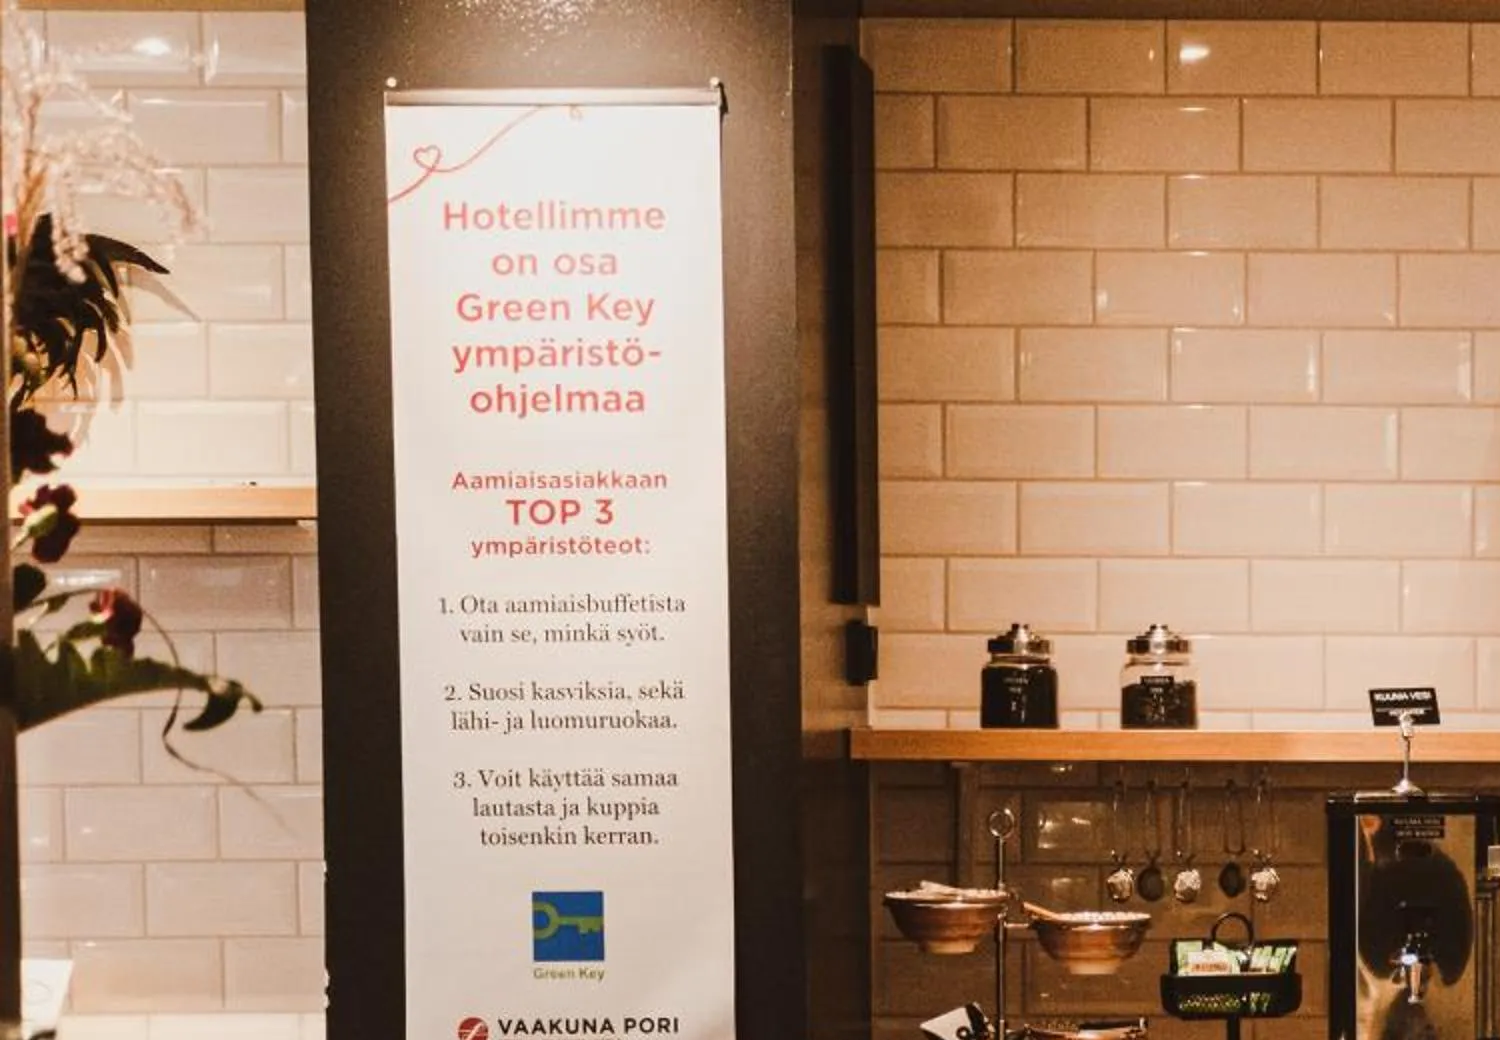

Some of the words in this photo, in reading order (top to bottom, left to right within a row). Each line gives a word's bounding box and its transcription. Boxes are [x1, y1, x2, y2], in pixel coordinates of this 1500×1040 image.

[442, 200, 667, 232] Hotellimme
[490, 252, 539, 277] on
[552, 252, 619, 277] osa
[455, 291, 572, 324] Green
[585, 291, 657, 328] Key
[451, 336, 663, 375] ympäristö-
[469, 383, 646, 420] ohjelmaa
[451, 469, 669, 491] Aamiaisasiakkaan
[505, 498, 582, 527] TOP
[594, 498, 615, 526] 3
[470, 535, 651, 560] ympäristöteot:
[439, 596, 454, 615] 1.
[459, 594, 499, 615] Ota
[505, 592, 687, 615] aamiaisbuffetista
[460, 623, 505, 644] vain
[510, 629, 538, 646] se,
[543, 622, 611, 644] minkä
[616, 623, 666, 648] syöt.
[444, 684, 463, 702] 2.
[468, 681, 526, 702] Suosi
[638, 679, 685, 701] sekä
[451, 709, 500, 731] lähi-
[503, 710, 525, 735] ja
[530, 708, 679, 731] luomuruokaa.
[453, 770, 472, 789] 3.
[477, 768, 523, 789] Voit
[528, 767, 606, 793] käyttää
[611, 771, 679, 788] samaa
[472, 796, 557, 818] lautasta
[559, 796, 581, 822] ja
[586, 795, 661, 822] kuppia
[480, 825, 578, 846] toisenkin
[583, 824, 660, 847] kerran.
[532, 967, 575, 980] Green
[578, 967, 606, 983] Key
[497, 1017, 616, 1036] VAAKUNA
[622, 1016, 680, 1036] PORI
